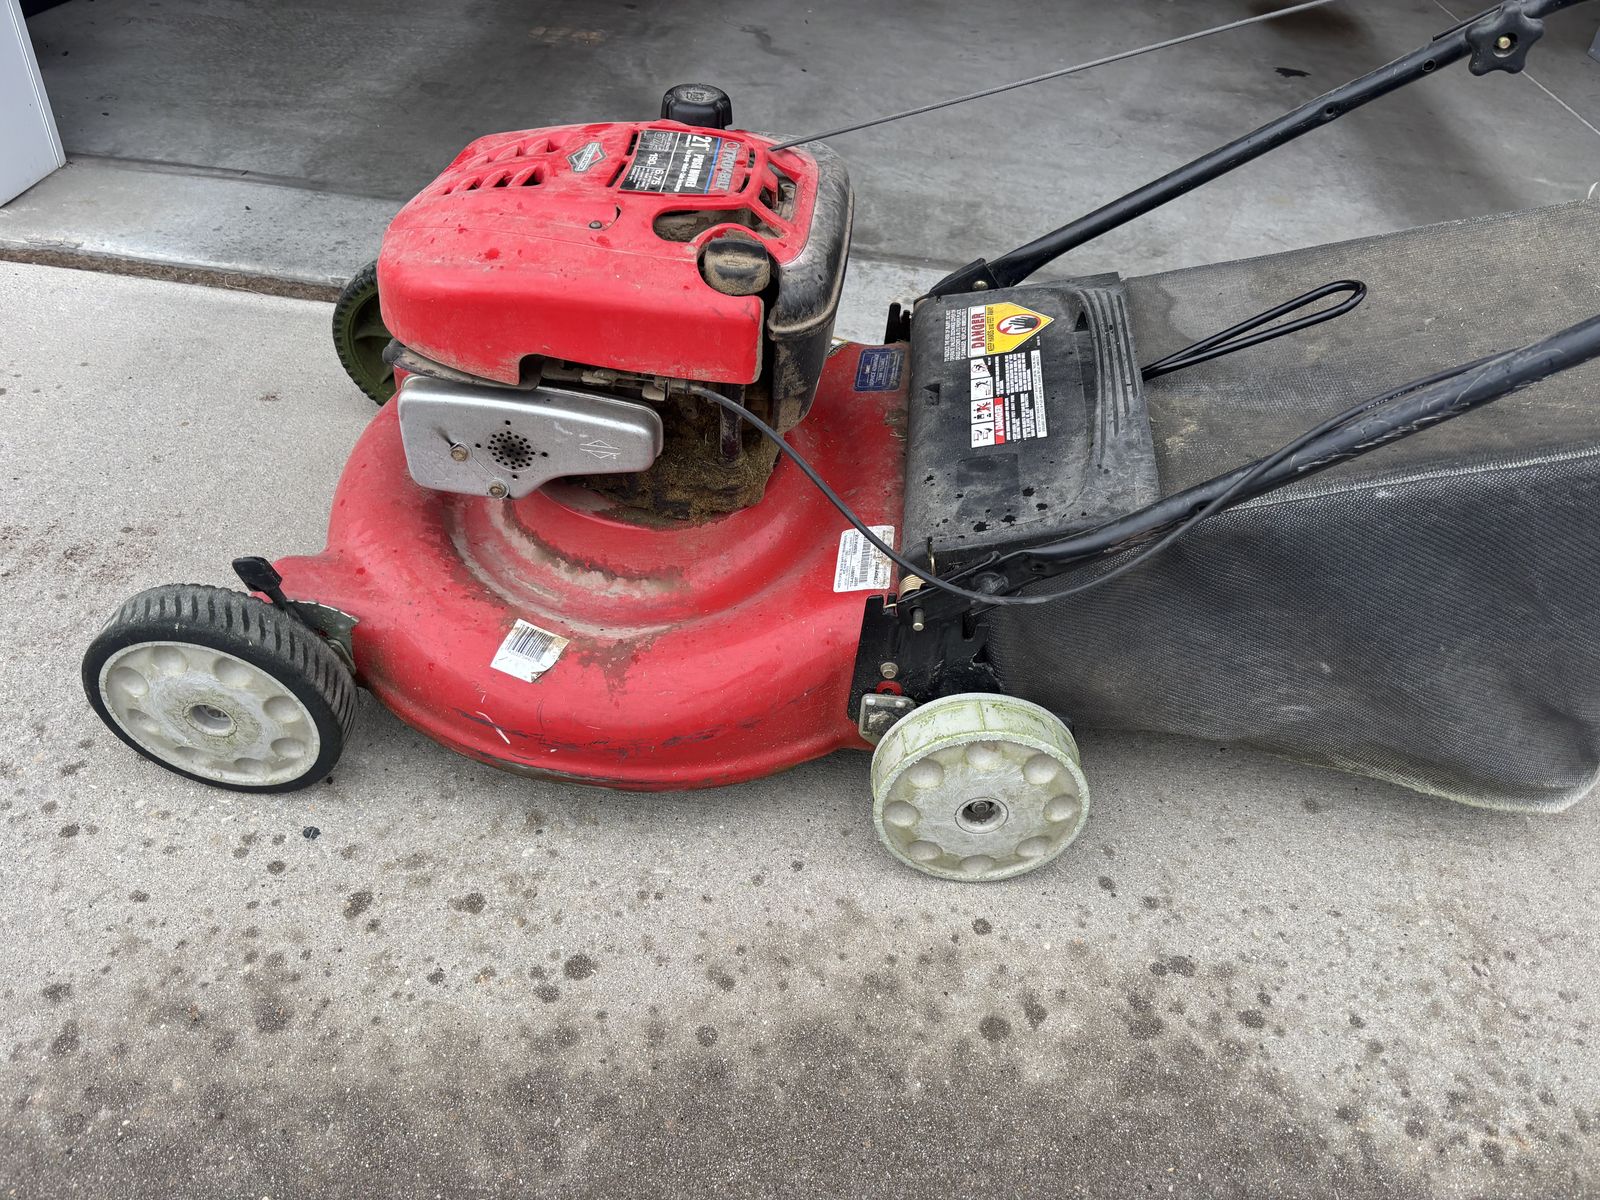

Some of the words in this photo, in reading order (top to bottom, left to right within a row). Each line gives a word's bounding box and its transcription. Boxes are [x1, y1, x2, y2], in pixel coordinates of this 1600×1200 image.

[691, 154, 704, 168] PUSH
[651, 169, 664, 185] 6.75
[685, 168, 701, 188] MOWER
[972, 313, 985, 348] DANGER
[994, 404, 1005, 429] DANGER
